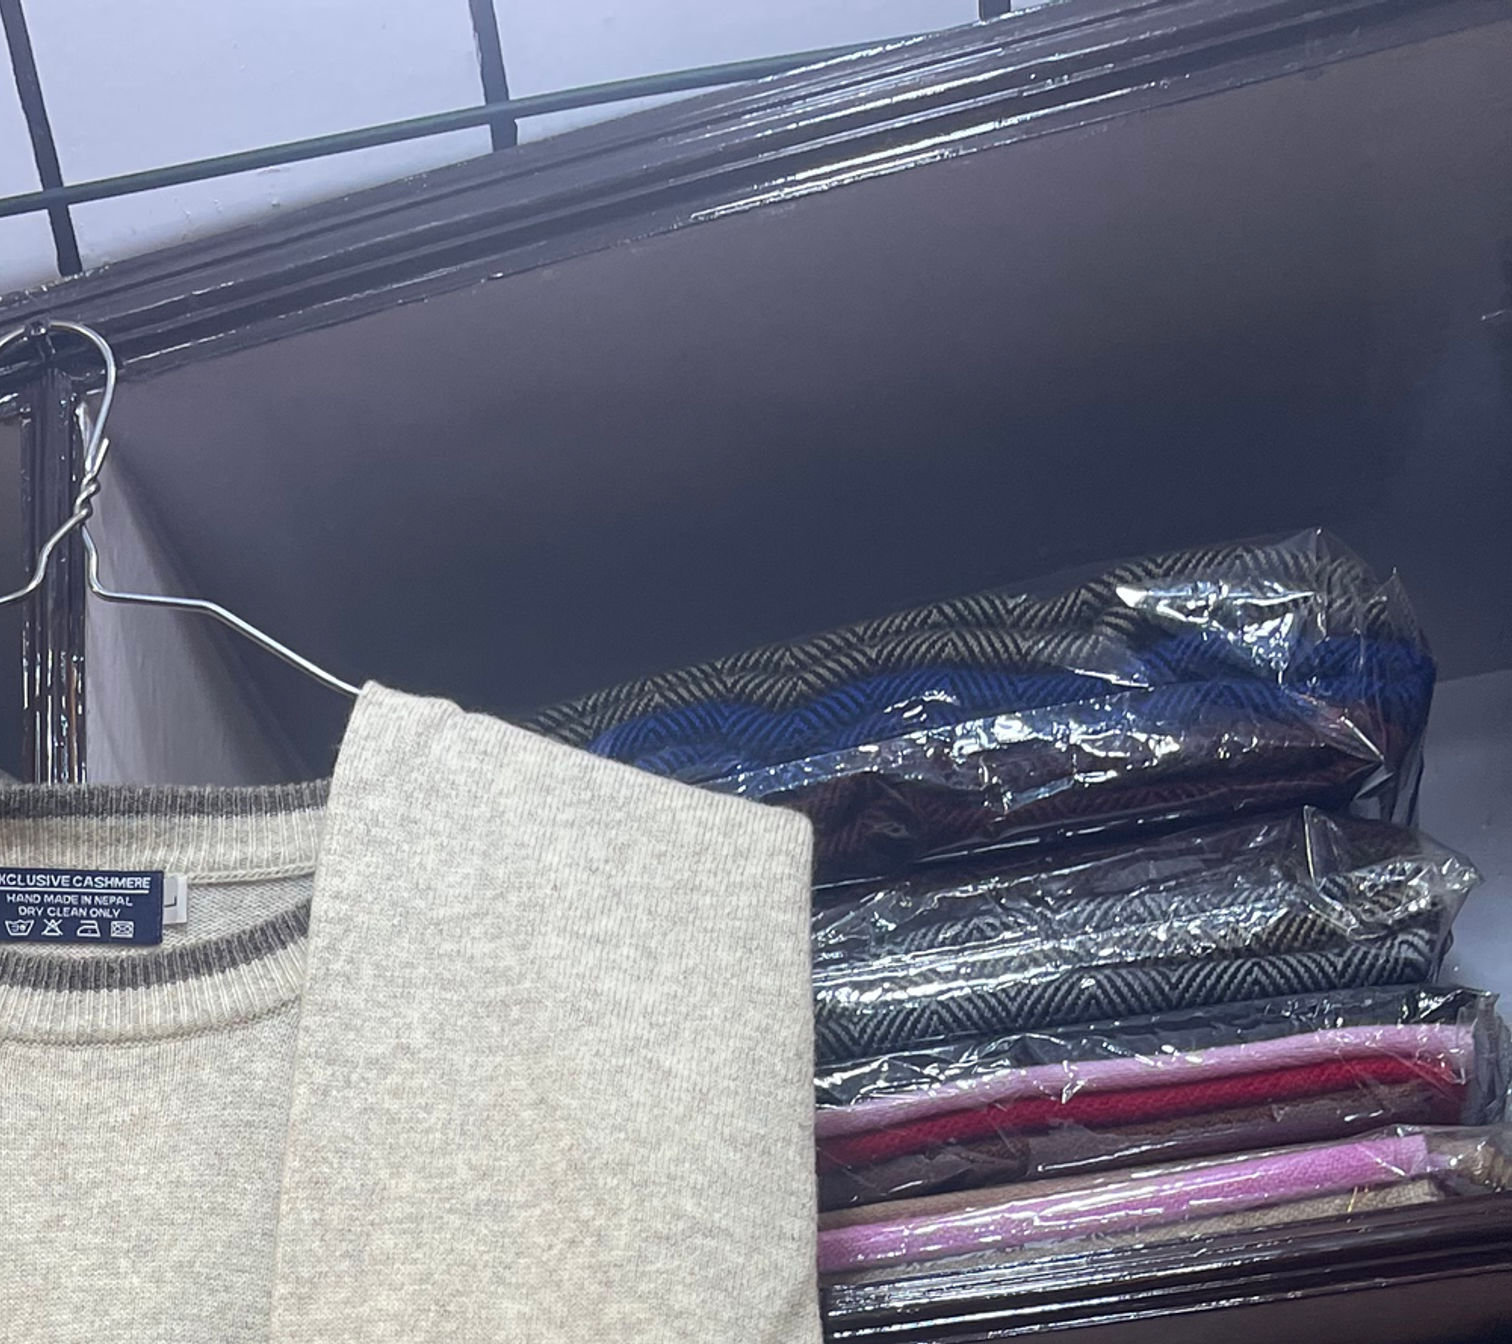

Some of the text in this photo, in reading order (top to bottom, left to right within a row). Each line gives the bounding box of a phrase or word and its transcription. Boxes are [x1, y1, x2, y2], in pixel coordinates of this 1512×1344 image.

[72, 876, 151, 889] CASHMERE
[6, 893, 133, 906] HAND MADE IN NEPAL
[18, 906, 121, 918] DRY CLEAN ONLY
